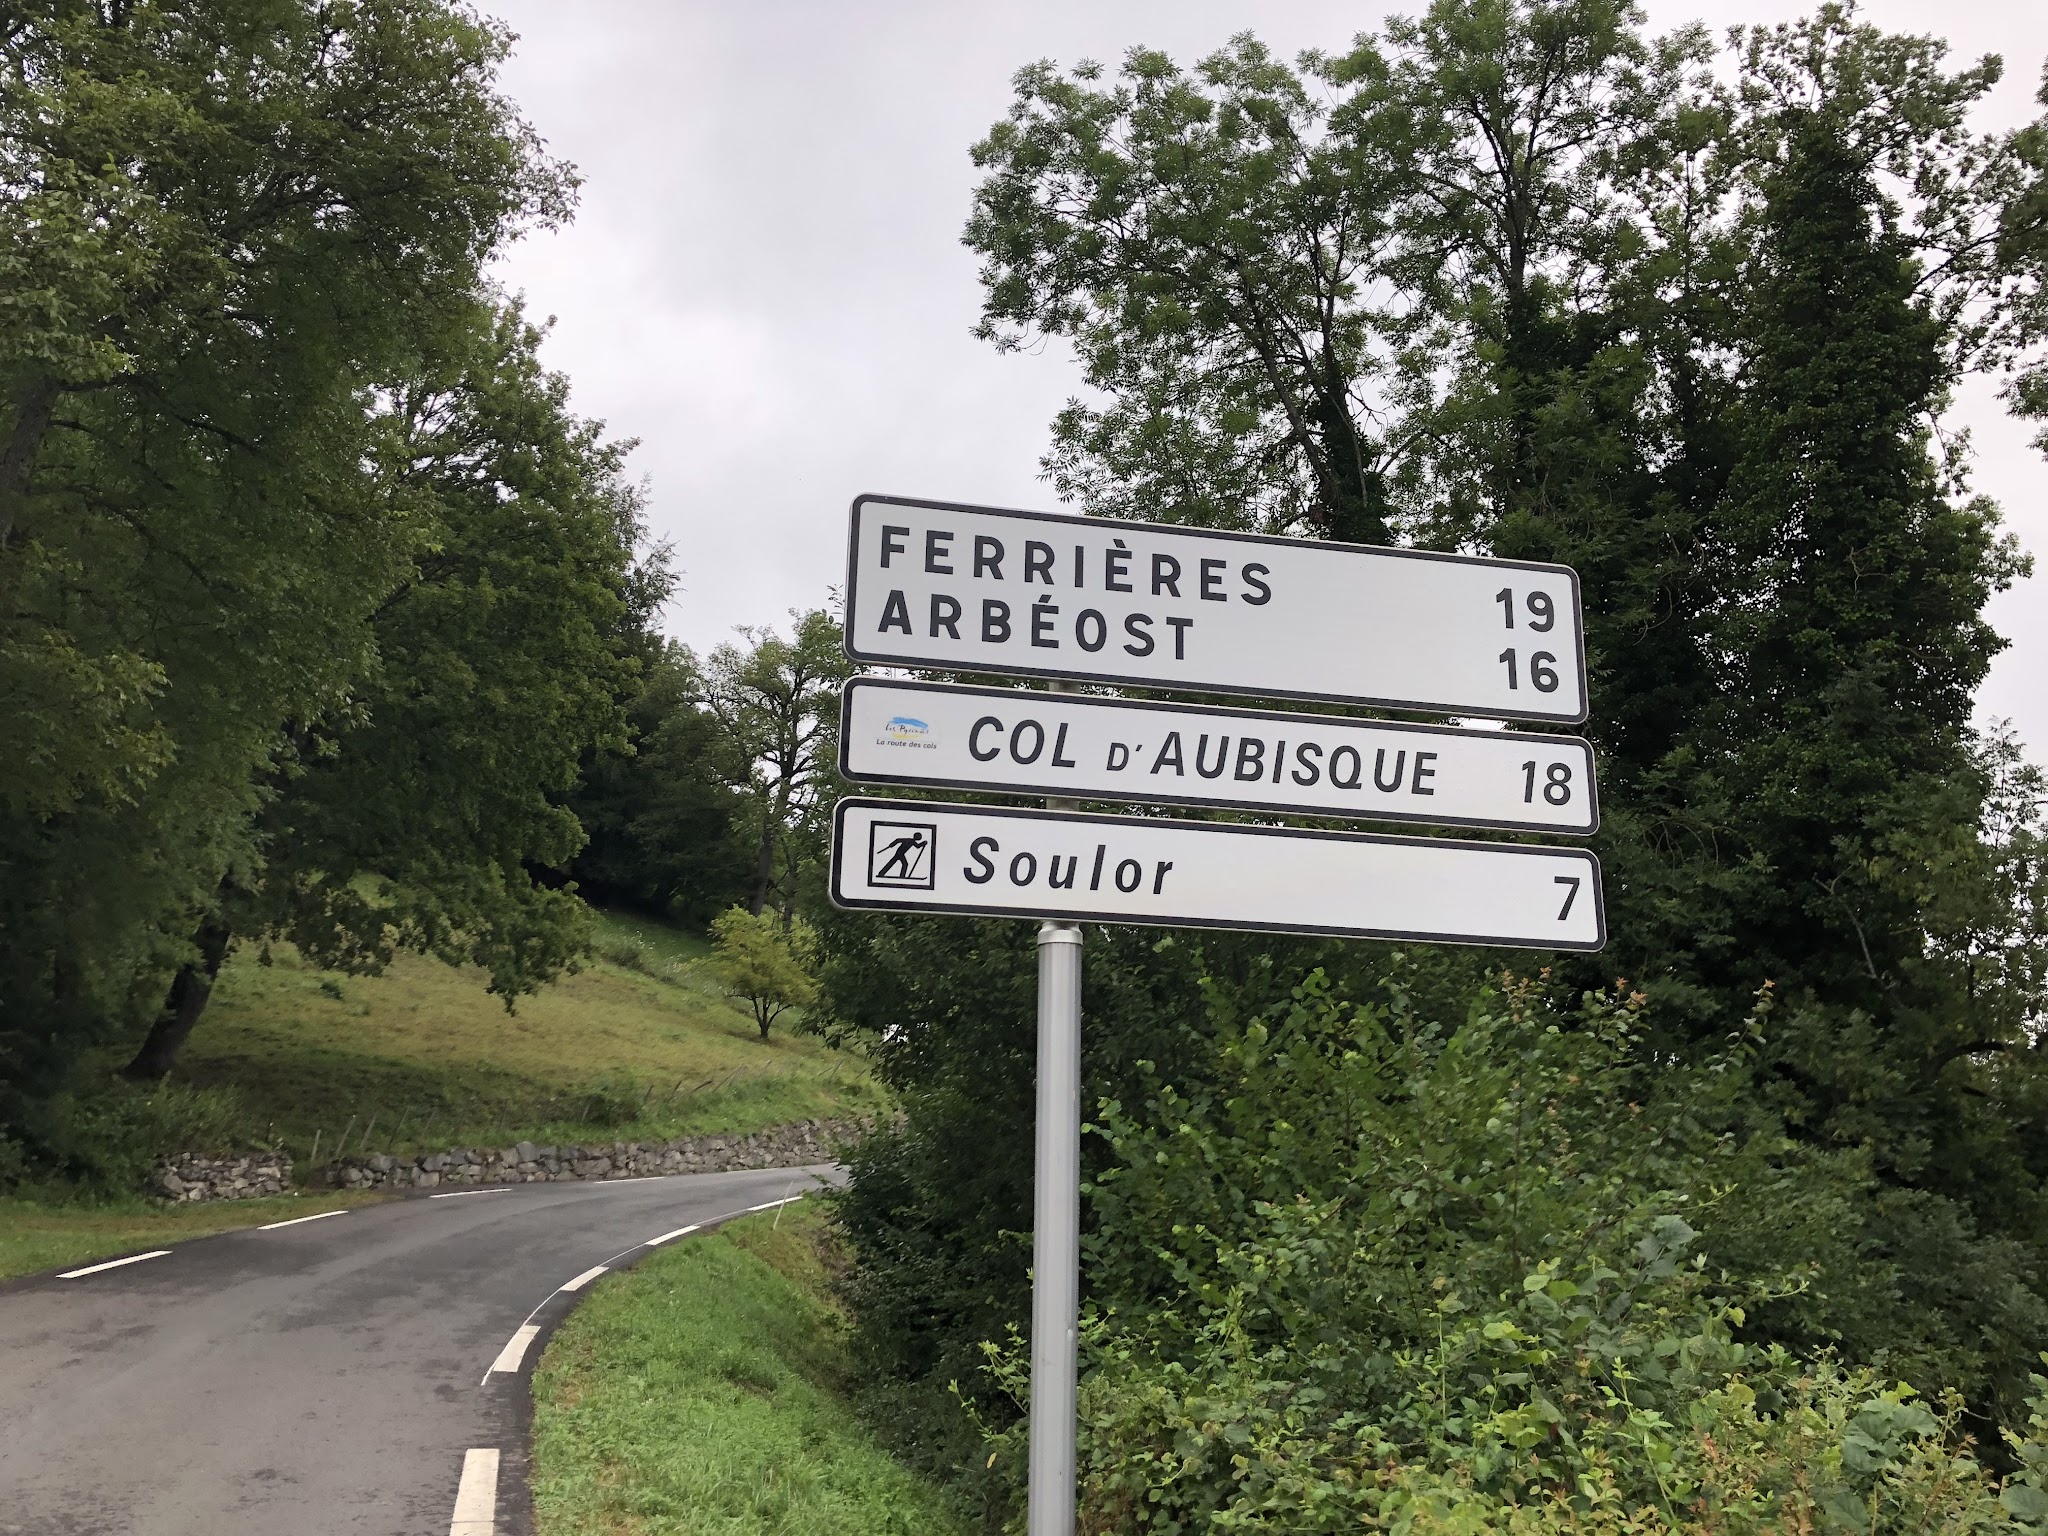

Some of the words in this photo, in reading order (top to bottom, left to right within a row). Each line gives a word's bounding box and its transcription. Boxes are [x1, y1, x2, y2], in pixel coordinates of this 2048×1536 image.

[880, 524, 1272, 606] FERRIÈRES
[1495, 587, 1555, 633] 19
[877, 589, 1194, 661] ARBÉOST
[1499, 647, 1559, 693] 16
[968, 715, 1076, 769] COL
[1521, 760, 1572, 806] 18
[963, 836, 1174, 895] Soulor
[1553, 875, 1580, 921] 7
